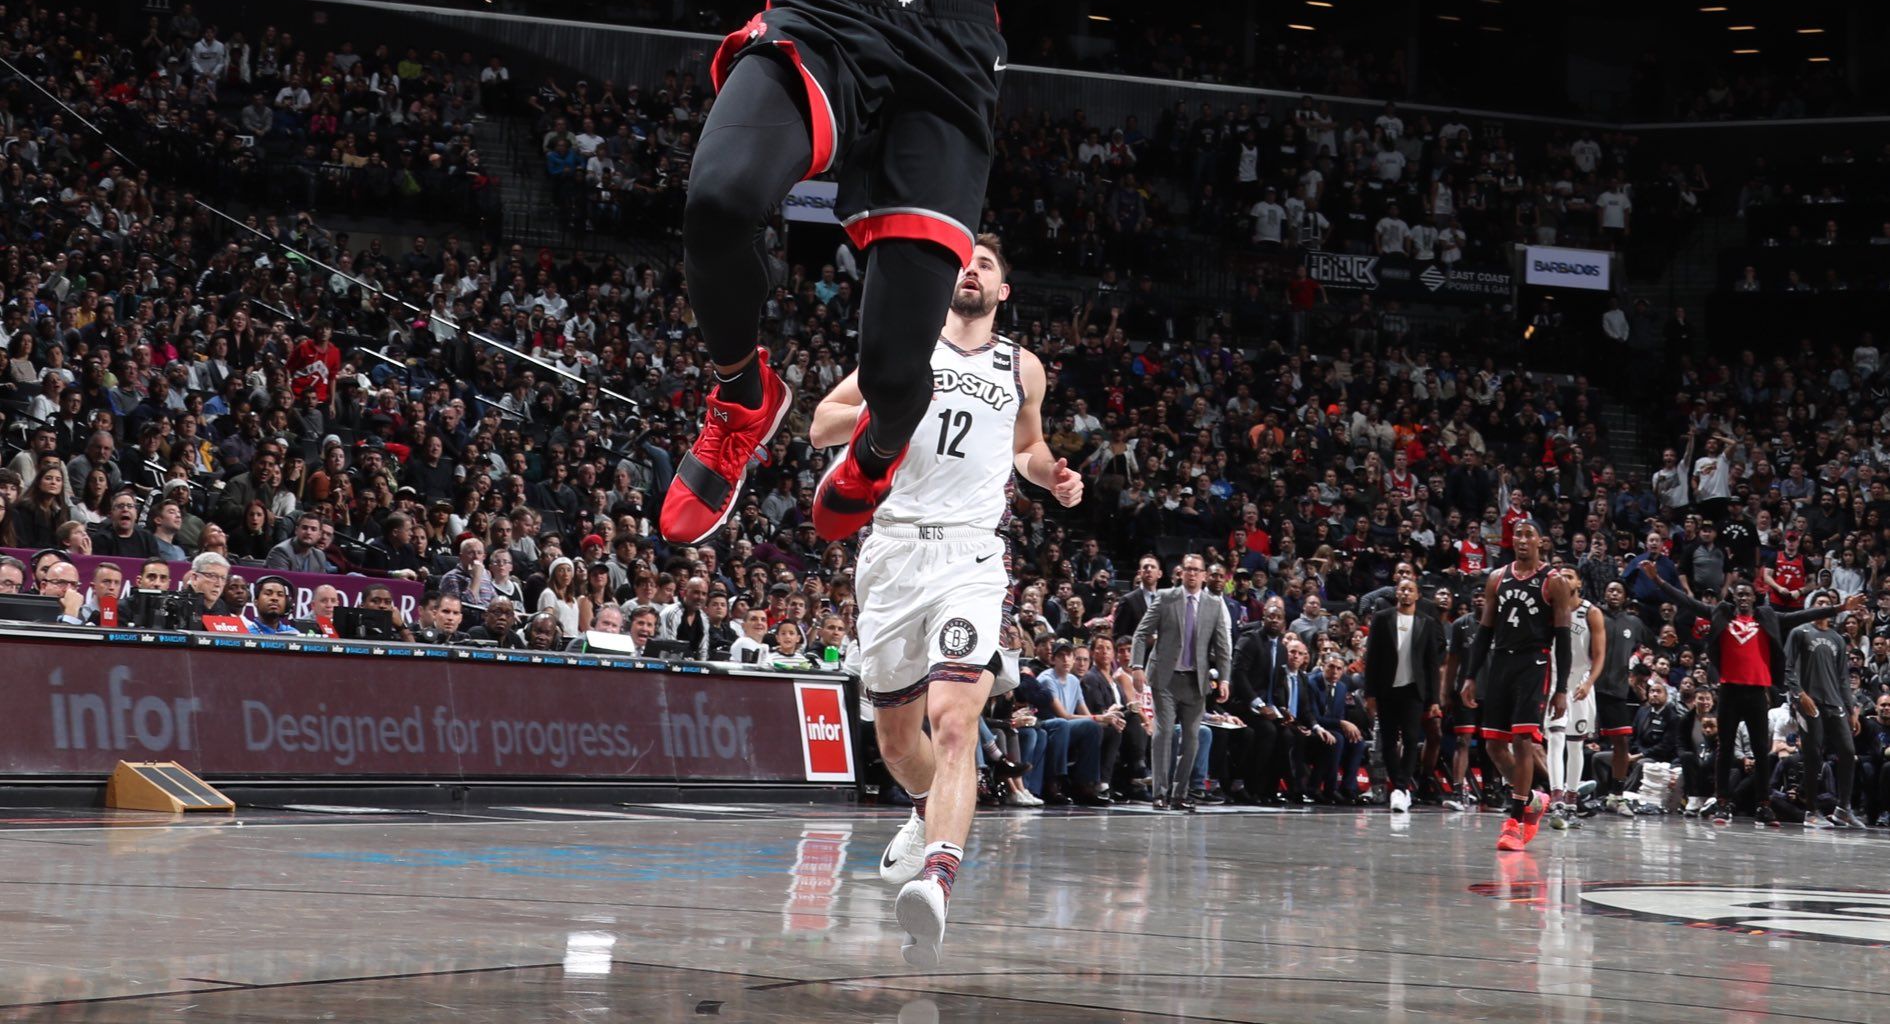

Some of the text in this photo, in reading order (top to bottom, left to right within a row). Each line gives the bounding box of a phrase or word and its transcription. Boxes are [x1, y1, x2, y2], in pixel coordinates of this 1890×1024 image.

[1450, 270, 1511, 285] EAST COAST
[1534, 260, 1600, 277] BARBADOS
[936, 408, 974, 459] 12
[918, 525, 944, 540] NETS
[1784, 574, 1793, 585] 7
[213, 622, 239, 632] infor
[1507, 607, 1520, 628] 4
[49, 665, 202, 751] infor
[243, 698, 638, 769] Designed for progress.
[659, 691, 754, 759] infor
[806, 715, 842, 742] infor
